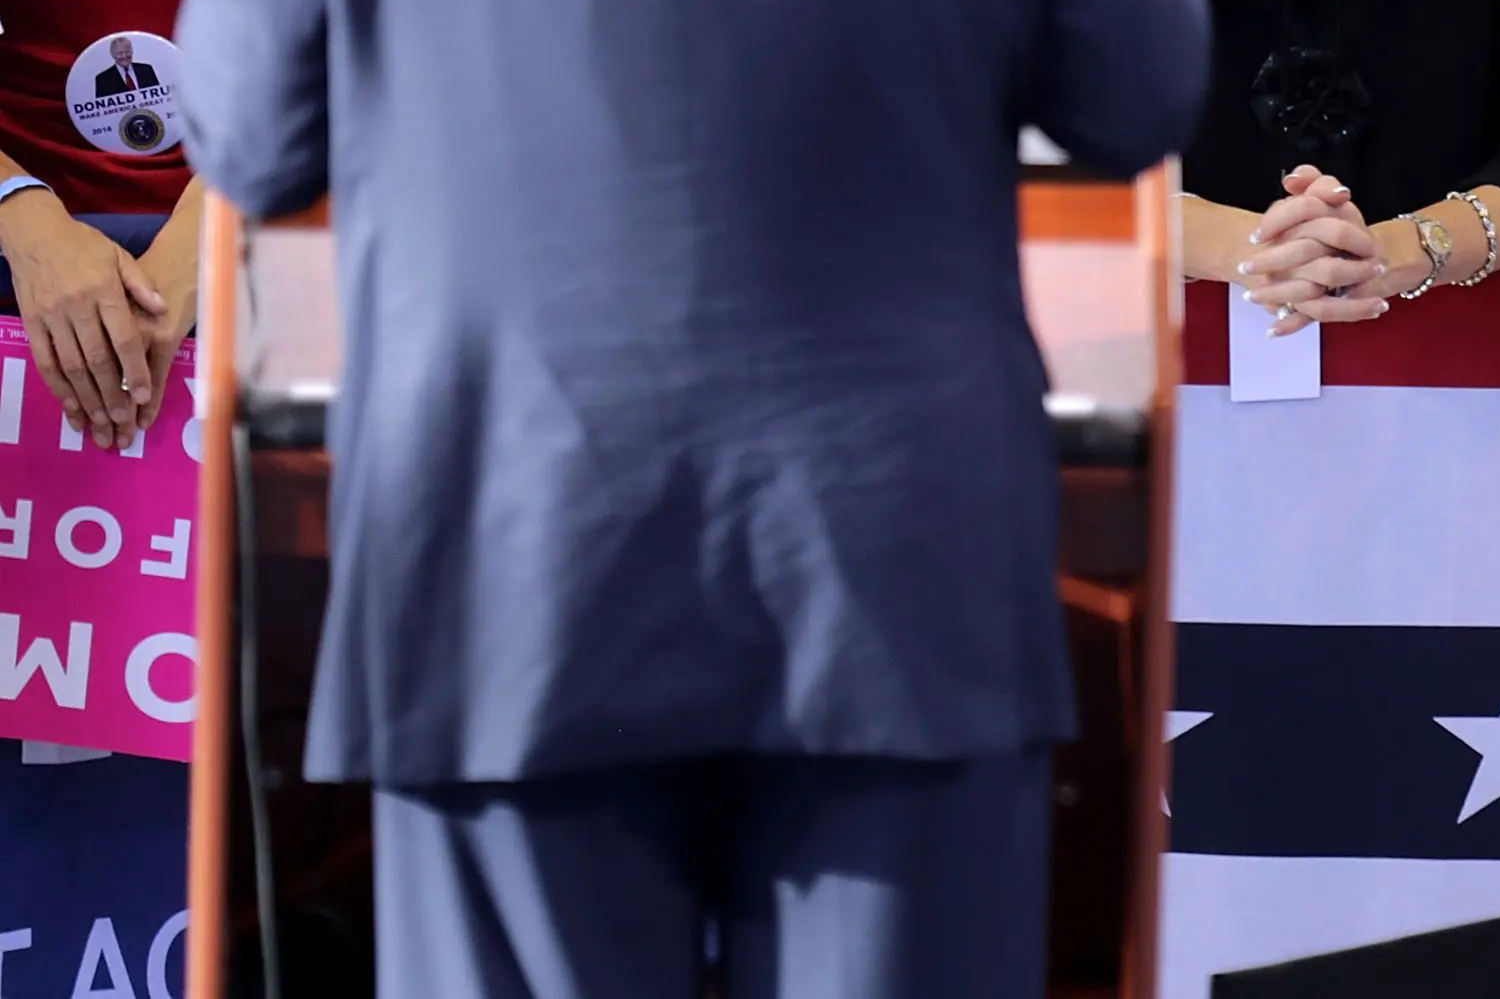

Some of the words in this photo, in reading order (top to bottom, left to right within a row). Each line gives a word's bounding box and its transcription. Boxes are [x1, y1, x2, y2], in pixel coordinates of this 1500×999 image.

[72, 93, 136, 115] DONALD
[139, 83, 176, 100] TRU
[79, 111, 100, 120] MAKE
[103, 104, 137, 116] AMERICA
[138, 98, 164, 108] GREAT
